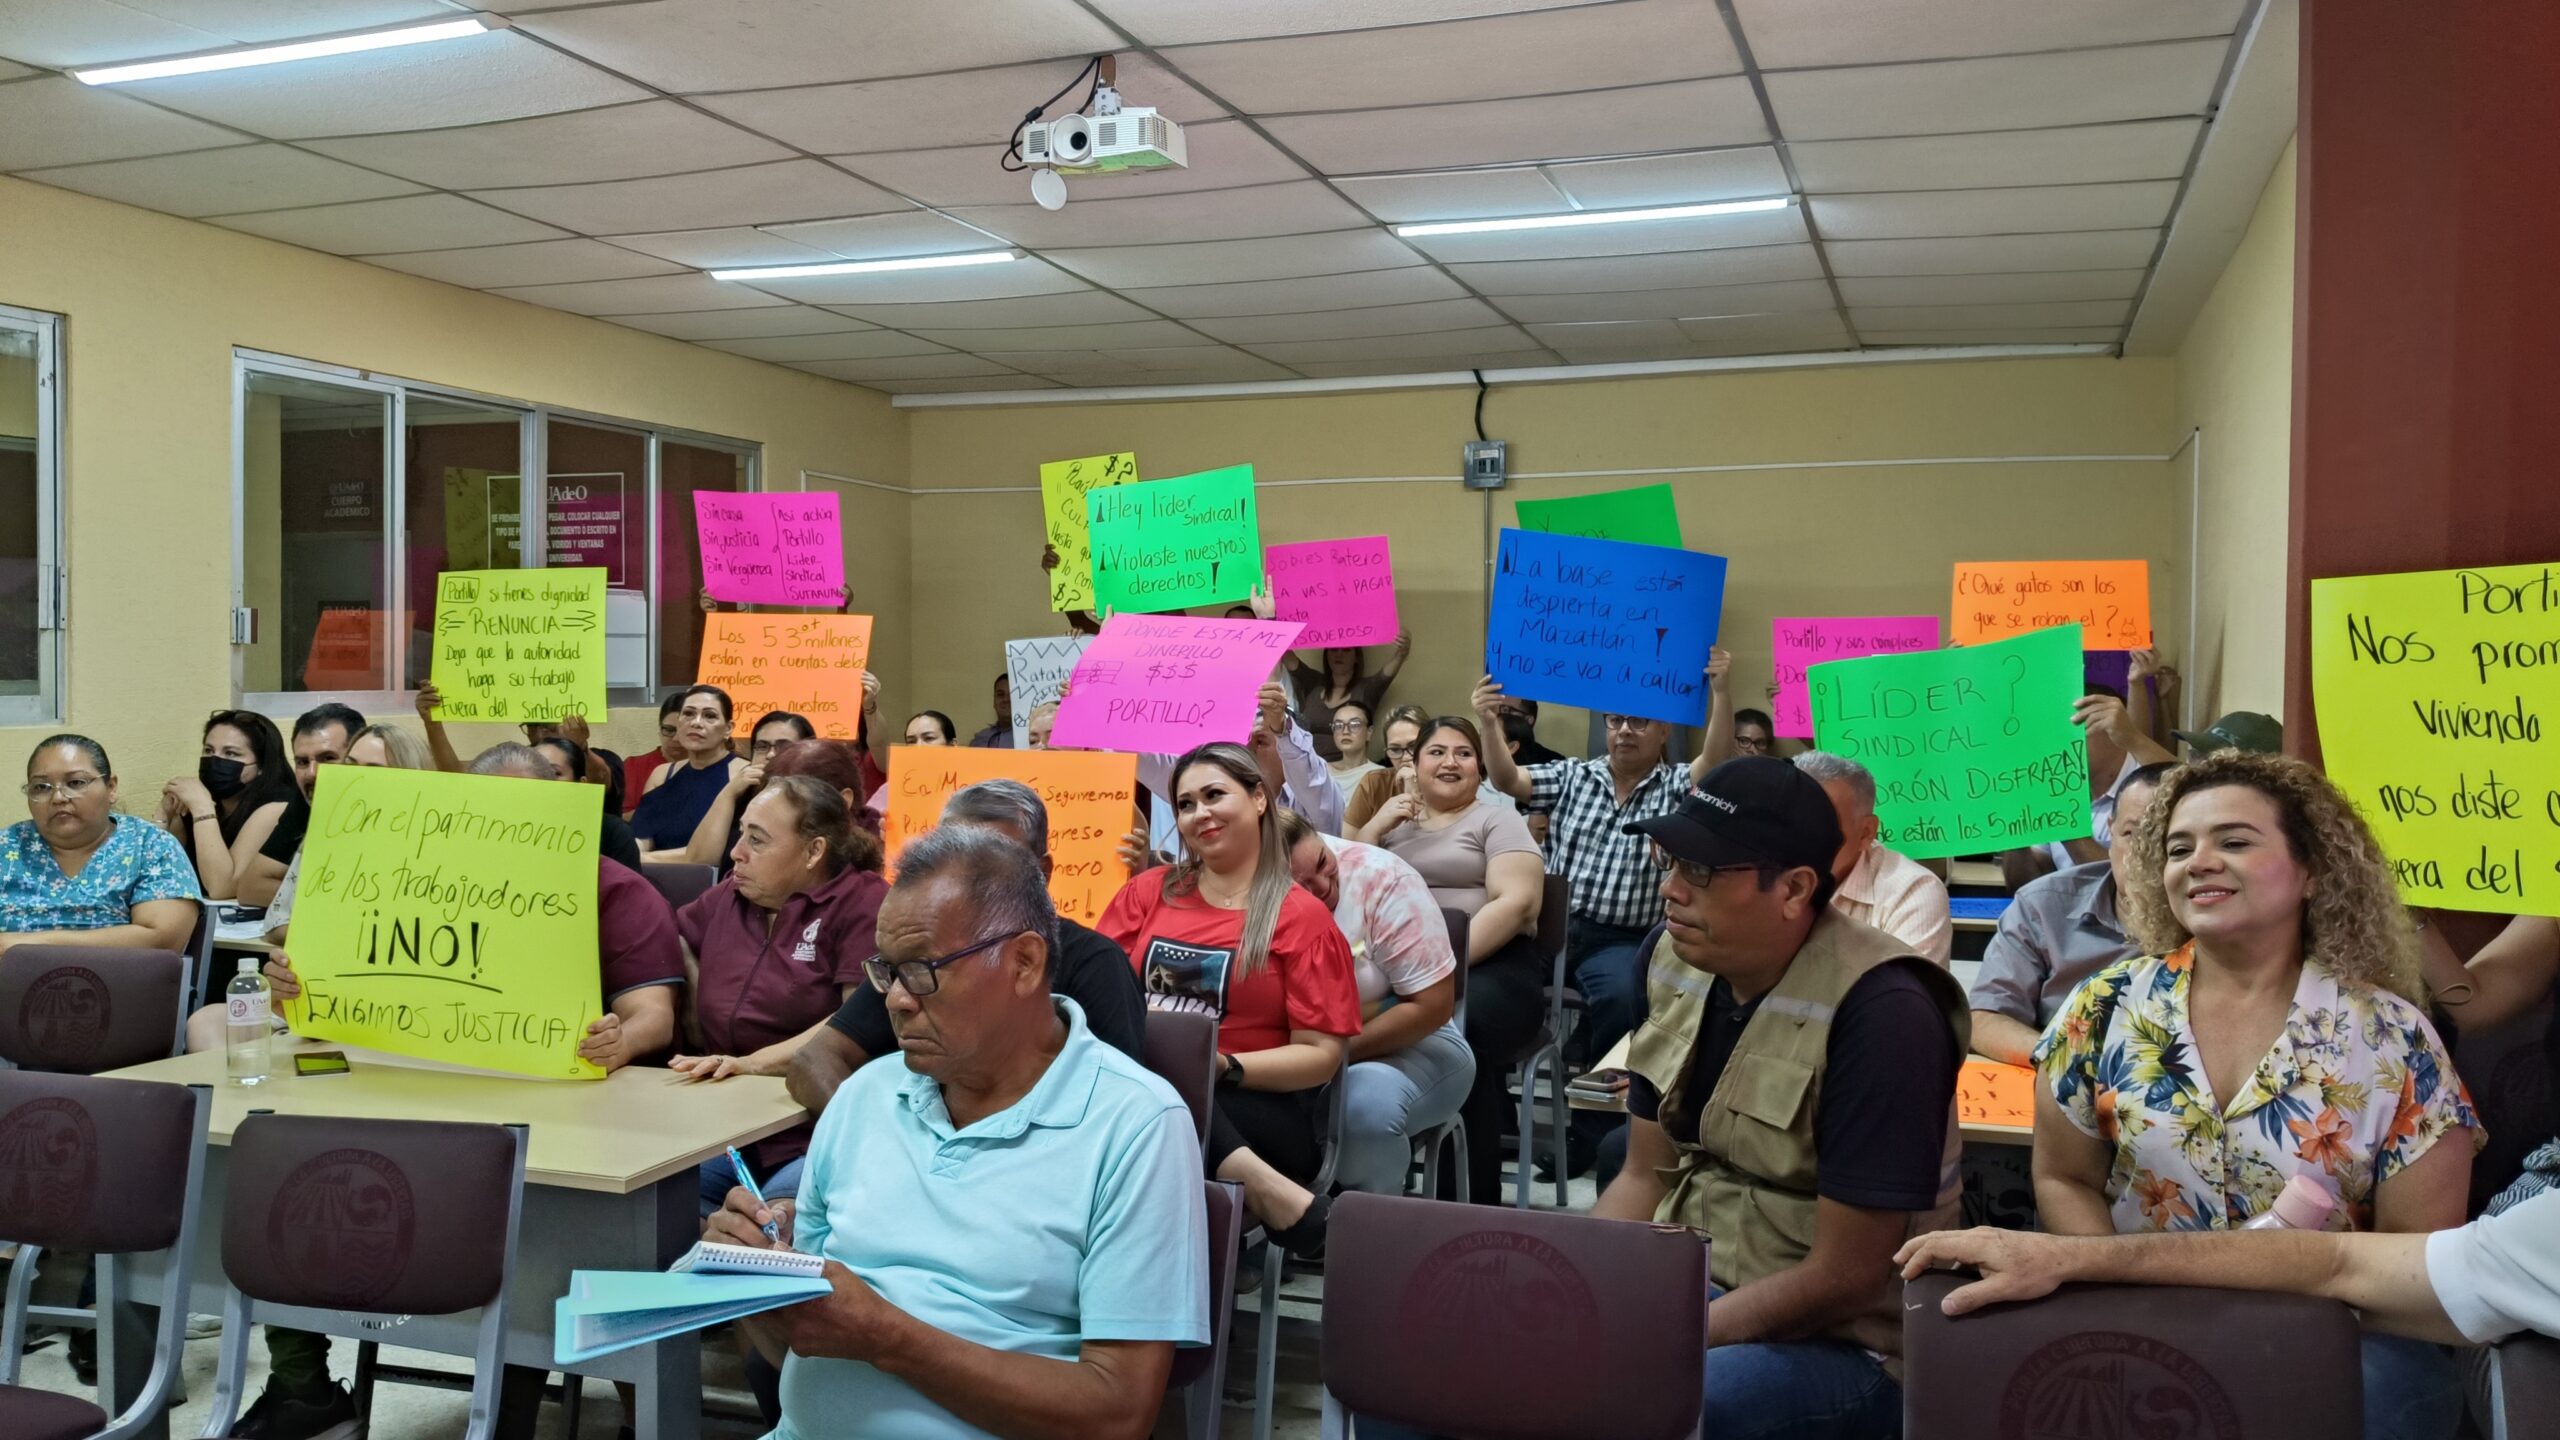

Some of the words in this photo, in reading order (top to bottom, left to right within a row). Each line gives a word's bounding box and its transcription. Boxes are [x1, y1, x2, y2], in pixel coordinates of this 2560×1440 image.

[701, 502, 720, 520] Sin
[703, 528, 718, 544] Sin
[719, 528, 760, 554] justicia
[782, 527, 824, 547] Portillo
[1185, 536, 1248, 565] nuestros
[704, 555, 723, 573] Sin
[1557, 551, 1616, 588] base
[503, 580, 535, 602] tienes
[541, 582, 591, 609] dignidad
[1302, 582, 1329, 599] VAS
[2013, 571, 2052, 606] gatos
[2061, 579, 2085, 593] son
[2095, 574, 2116, 595] los
[1517, 584, 1611, 617] despierta
[1626, 606, 1660, 623] en
[468, 607, 561, 636] RENUNCIA
[719, 621, 747, 645] Los
[805, 628, 865, 649] millones
[1973, 611, 1998, 635] que
[2006, 613, 2025, 628] se
[2080, 608, 2096, 627] el
[1194, 625, 1251, 642] ESTÁ
[1249, 631, 1288, 648] MI
[1783, 624, 1826, 652] Portillo
[1835, 636, 1842, 653] y
[1846, 636, 1865, 649] sus
[2347, 613, 2435, 665] Nos
[476, 647, 496, 667] que
[523, 640, 582, 660] autoridad
[710, 649, 744, 667] están
[752, 656, 768, 668] en
[779, 653, 829, 670] cuentas
[1135, 643, 1224, 660] DINERILLO
[706, 670, 766, 690] cómplices
[1011, 657, 1074, 683] Ratato
[1509, 653, 1535, 674] no
[1542, 660, 1567, 679] se
[1577, 661, 1603, 681] va
[1617, 665, 1631, 683] a
[466, 669, 495, 698] haga
[509, 673, 525, 687] su
[529, 667, 576, 694] trabajo
[488, 697, 508, 718] del
[788, 691, 839, 713] nuestros
[1107, 698, 1216, 728] PORTILLO?
[1841, 726, 1988, 759] SINDICAL
[903, 769, 932, 797] En
[2379, 784, 2437, 822] nos
[2452, 769, 2523, 820] diste
[326, 776, 382, 839] Con
[390, 791, 421, 841] el
[417, 800, 586, 860] patrimonio
[1903, 816, 1948, 843] están
[1957, 815, 1982, 839] los
[2466, 845, 2524, 898] del
[305, 854, 336, 898] de
[341, 853, 380, 903] los
[391, 858, 578, 922] trabajadores
